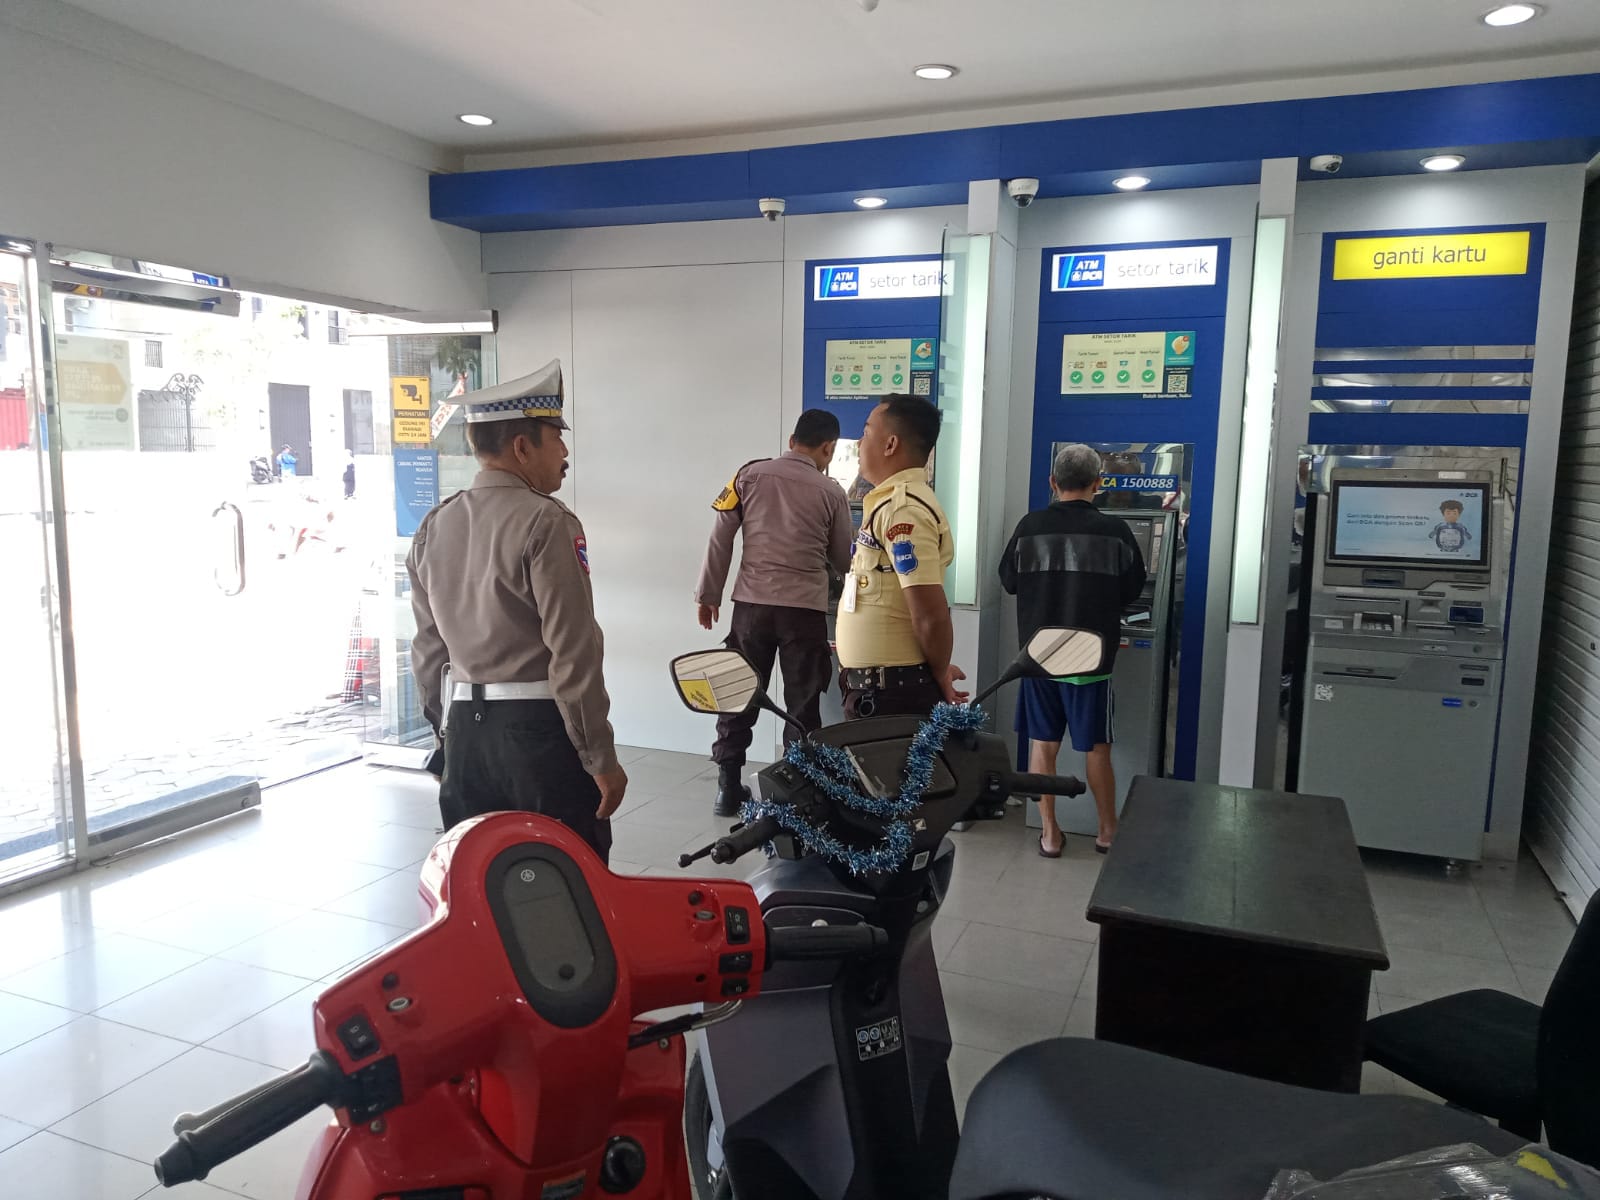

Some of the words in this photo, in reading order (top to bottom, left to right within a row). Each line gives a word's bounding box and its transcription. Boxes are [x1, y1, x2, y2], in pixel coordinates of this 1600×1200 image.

[1075, 260, 1100, 270] ATM
[1373, 246, 1424, 270] ganti
[1432, 245, 1487, 264] kartu
[1117, 262, 1161, 278] setor
[1169, 258, 1210, 275] tarik
[833, 271, 854, 282] ATM
[869, 273, 907, 289] setor
[912, 270, 949, 287] tarik
[1099, 477, 1118, 488] CA
[1121, 477, 1175, 489] 1500888
